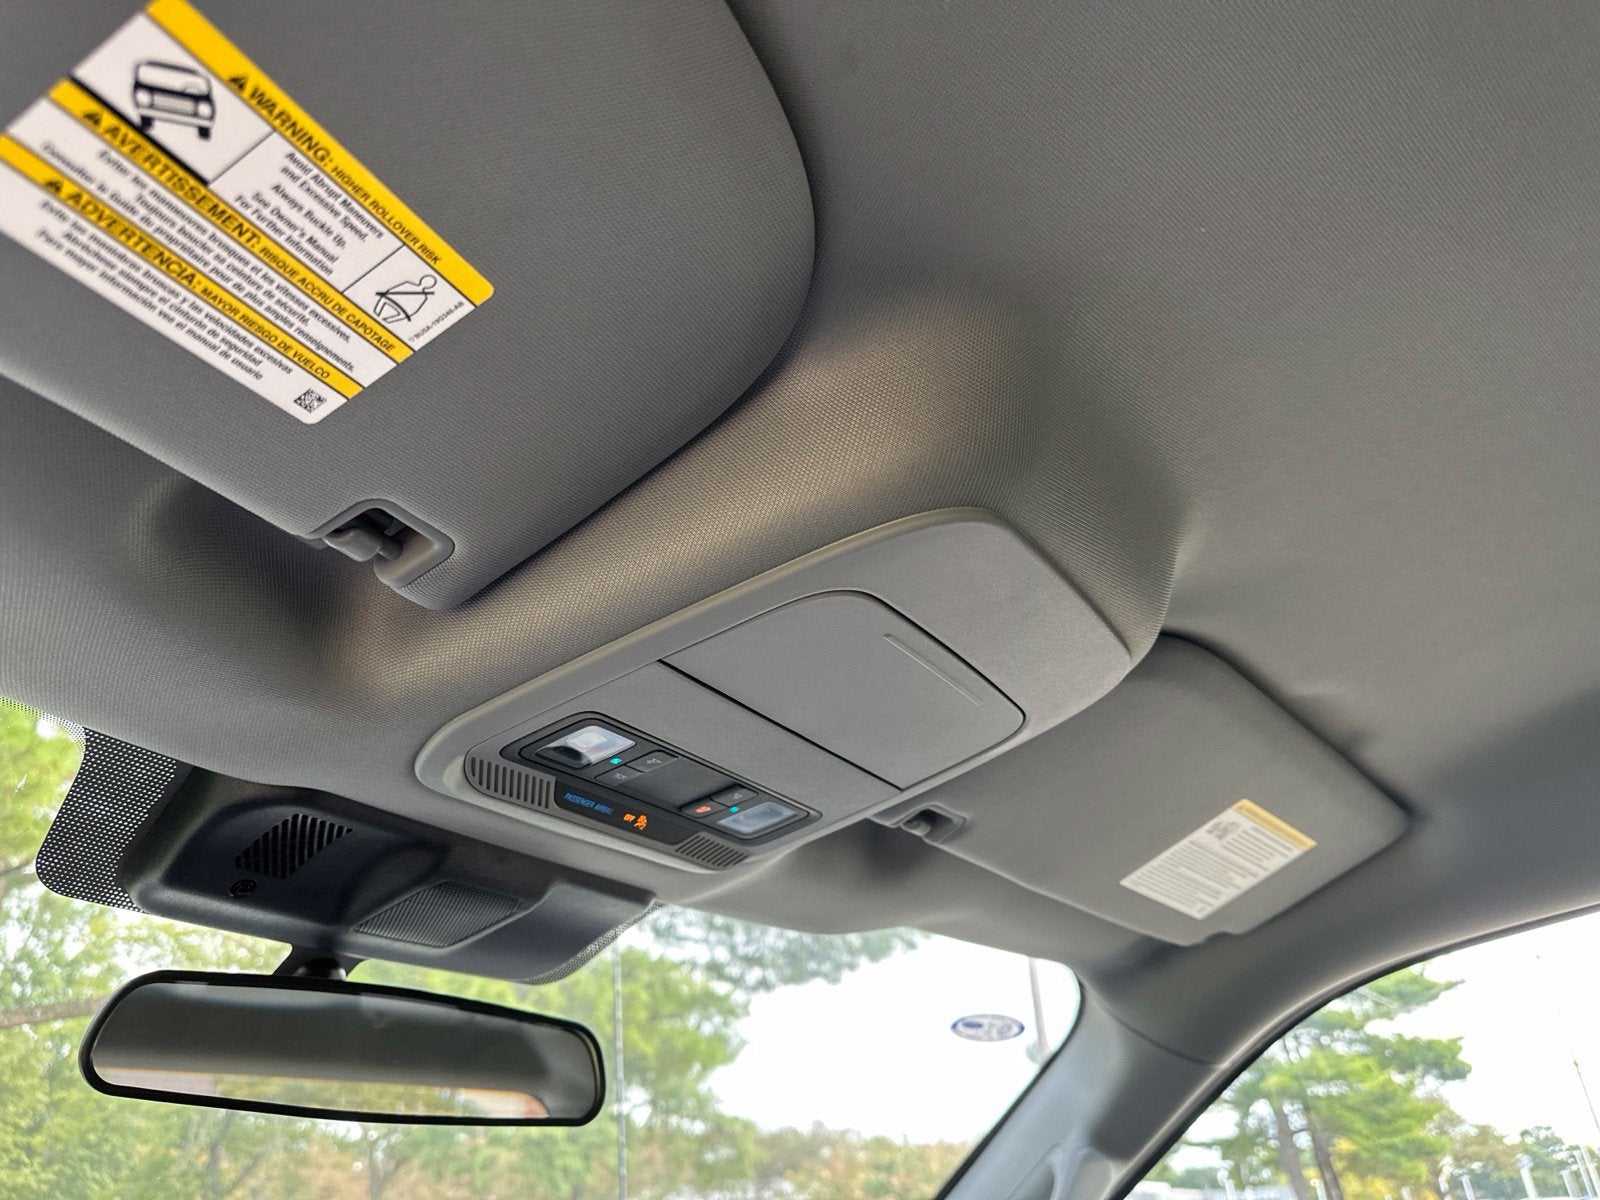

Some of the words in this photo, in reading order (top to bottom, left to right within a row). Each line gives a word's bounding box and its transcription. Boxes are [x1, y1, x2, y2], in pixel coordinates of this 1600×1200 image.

[245, 89, 337, 167] WARNING:
[328, 165, 373, 202] HIGHER
[365, 199, 422, 246] ROLLOVER
[415, 242, 443, 265] RISK
[267, 182, 306, 214] Always
[302, 209, 337, 237] Buckle
[330, 233, 350, 250] Up.
[279, 165, 301, 183] and
[296, 180, 344, 219] Excessive
[337, 215, 371, 243] Speed.
[283, 151, 313, 176] Avoid
[307, 173, 343, 202] Abrupt
[337, 198, 387, 239] Maneuvers
[99, 122, 267, 248] AVERTISSEMENT:
[256, 245, 302, 279] RISQUE
[294, 275, 336, 305] ACCRU
[343, 312, 397, 352] CAPOTAGE
[232, 194, 254, 211] For
[248, 207, 288, 238] Further
[282, 234, 336, 276] Information
[249, 192, 272, 210] See
[267, 206, 309, 239] Owner's
[303, 235, 340, 263] Manual
[61, 189, 207, 290] ADVERTENCIA:
[198, 286, 242, 317] MAYOR
[236, 313, 280, 344] RIESGO
[288, 350, 332, 379] VUELCO
[204, 231, 254, 268] brusques
[259, 271, 278, 286] les
[272, 282, 312, 311] vitesses
[306, 307, 356, 343] excessives.
[224, 261, 266, 291] ceinture
[139, 269, 184, 299] bruscas
[186, 301, 205, 314] las
[200, 311, 257, 349] velocidades
[251, 345, 296, 375] excesivas
[155, 308, 178, 324] vea
[183, 326, 222, 352] manual
[228, 356, 266, 381] usuario
[166, 302, 210, 331] cinturón
[216, 336, 263, 367] seguridad
[208, 266, 233, 285] pour
[242, 290, 267, 308] plus
[261, 304, 297, 330] amples
[290, 326, 359, 373] renseignements.
[563, 792, 595, 808] PASSENGER
